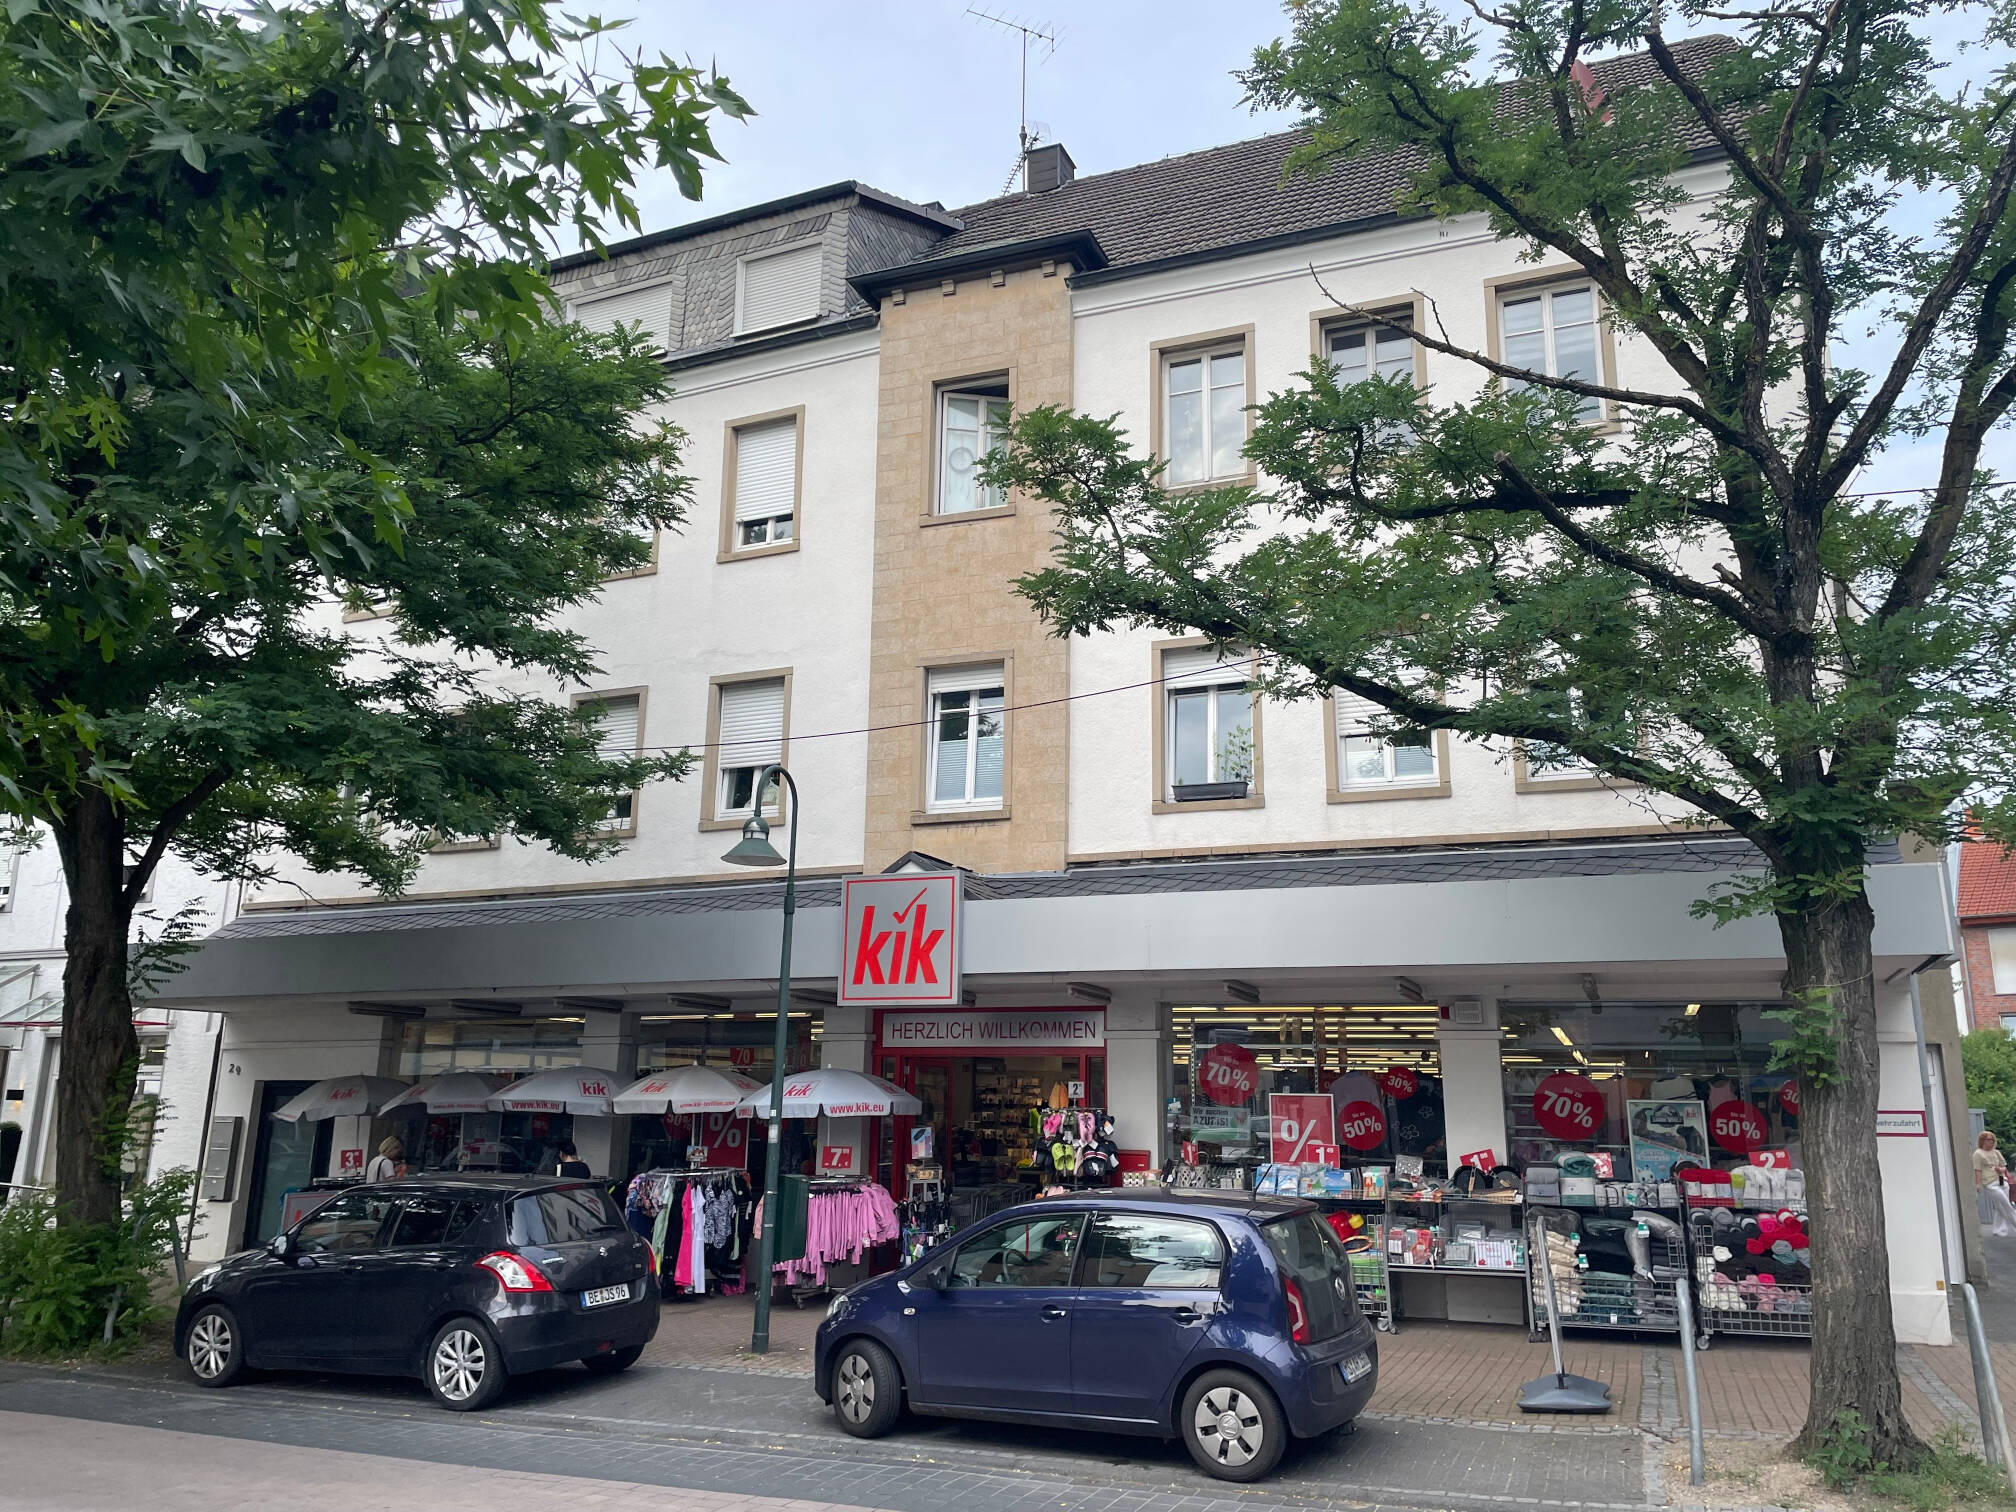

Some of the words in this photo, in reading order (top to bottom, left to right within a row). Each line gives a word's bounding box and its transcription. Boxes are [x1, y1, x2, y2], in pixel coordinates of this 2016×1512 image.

[852, 888, 945, 985] kik
[891, 1022, 973, 1040] HERZLICH
[978, 1021, 1096, 1039] WILLKOMMEN
[228, 1063, 242, 1076] 29
[1206, 1061, 1251, 1092] 70%
[582, 1082, 607, 1096] kik
[783, 1083, 813, 1097] kik
[1387, 1075, 1413, 1093] 30%
[829, 1102, 885, 1114] www.kik.eu
[1541, 1090, 1594, 1129] 70%
[1343, 1116, 1382, 1139] 50%
[1716, 1118, 1761, 1139] 50%
[588, 1291, 600, 1304] BE
[605, 1288, 615, 1301] JS
[616, 1286, 626, 1298] 96
